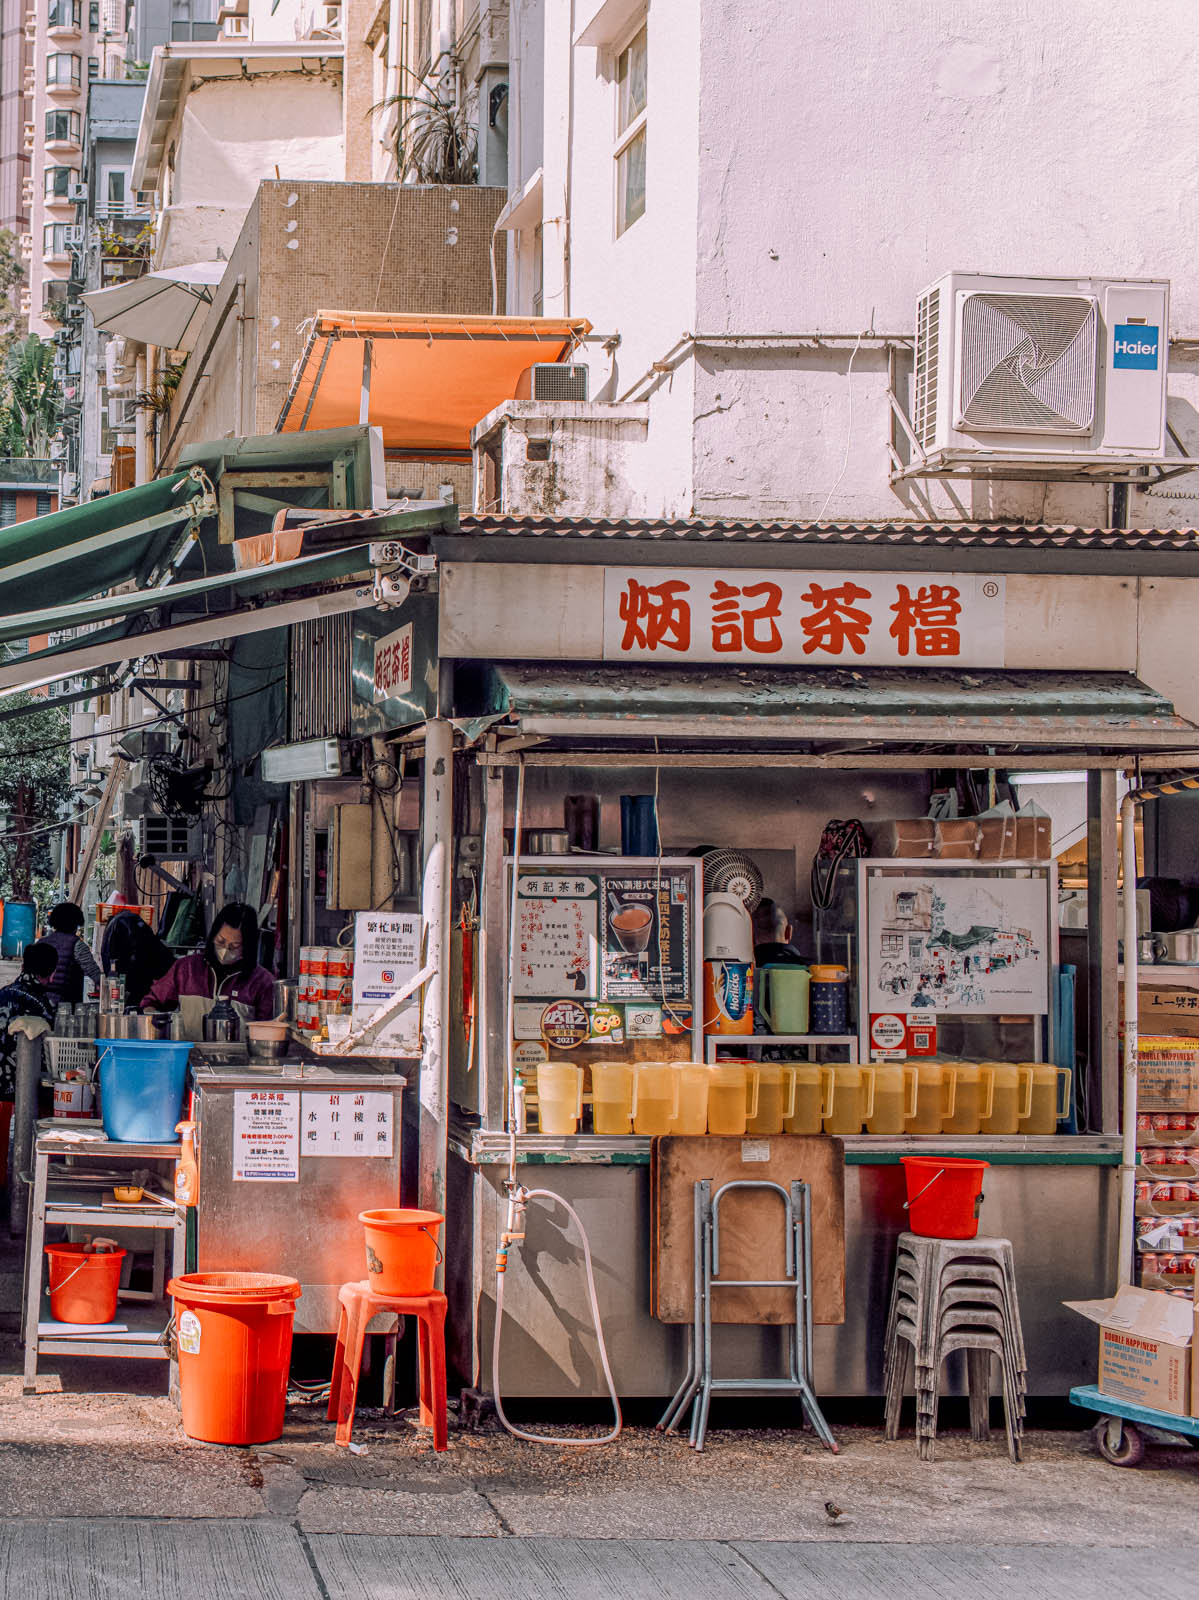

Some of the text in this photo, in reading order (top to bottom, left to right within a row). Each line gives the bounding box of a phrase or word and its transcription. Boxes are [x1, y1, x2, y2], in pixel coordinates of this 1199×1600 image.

[1115, 340, 1157, 355] Haier
[619, 577, 963, 658] 炳記茶檔
[526, 881, 586, 893] 炳記茶檔
[367, 921, 413, 934] 繁忙時間
[729, 972, 740, 1011] Horlicks
[1151, 994, 1198, 1009] 出前一丁
[544, 1010, 587, 1024] 必吃
[1161, 1052, 1195, 1061] HAPPINESS
[250, 1093, 285, 1101] 炳記茶檔
[1104, 1332, 1158, 1353] DOUBLE HAPPINESS
